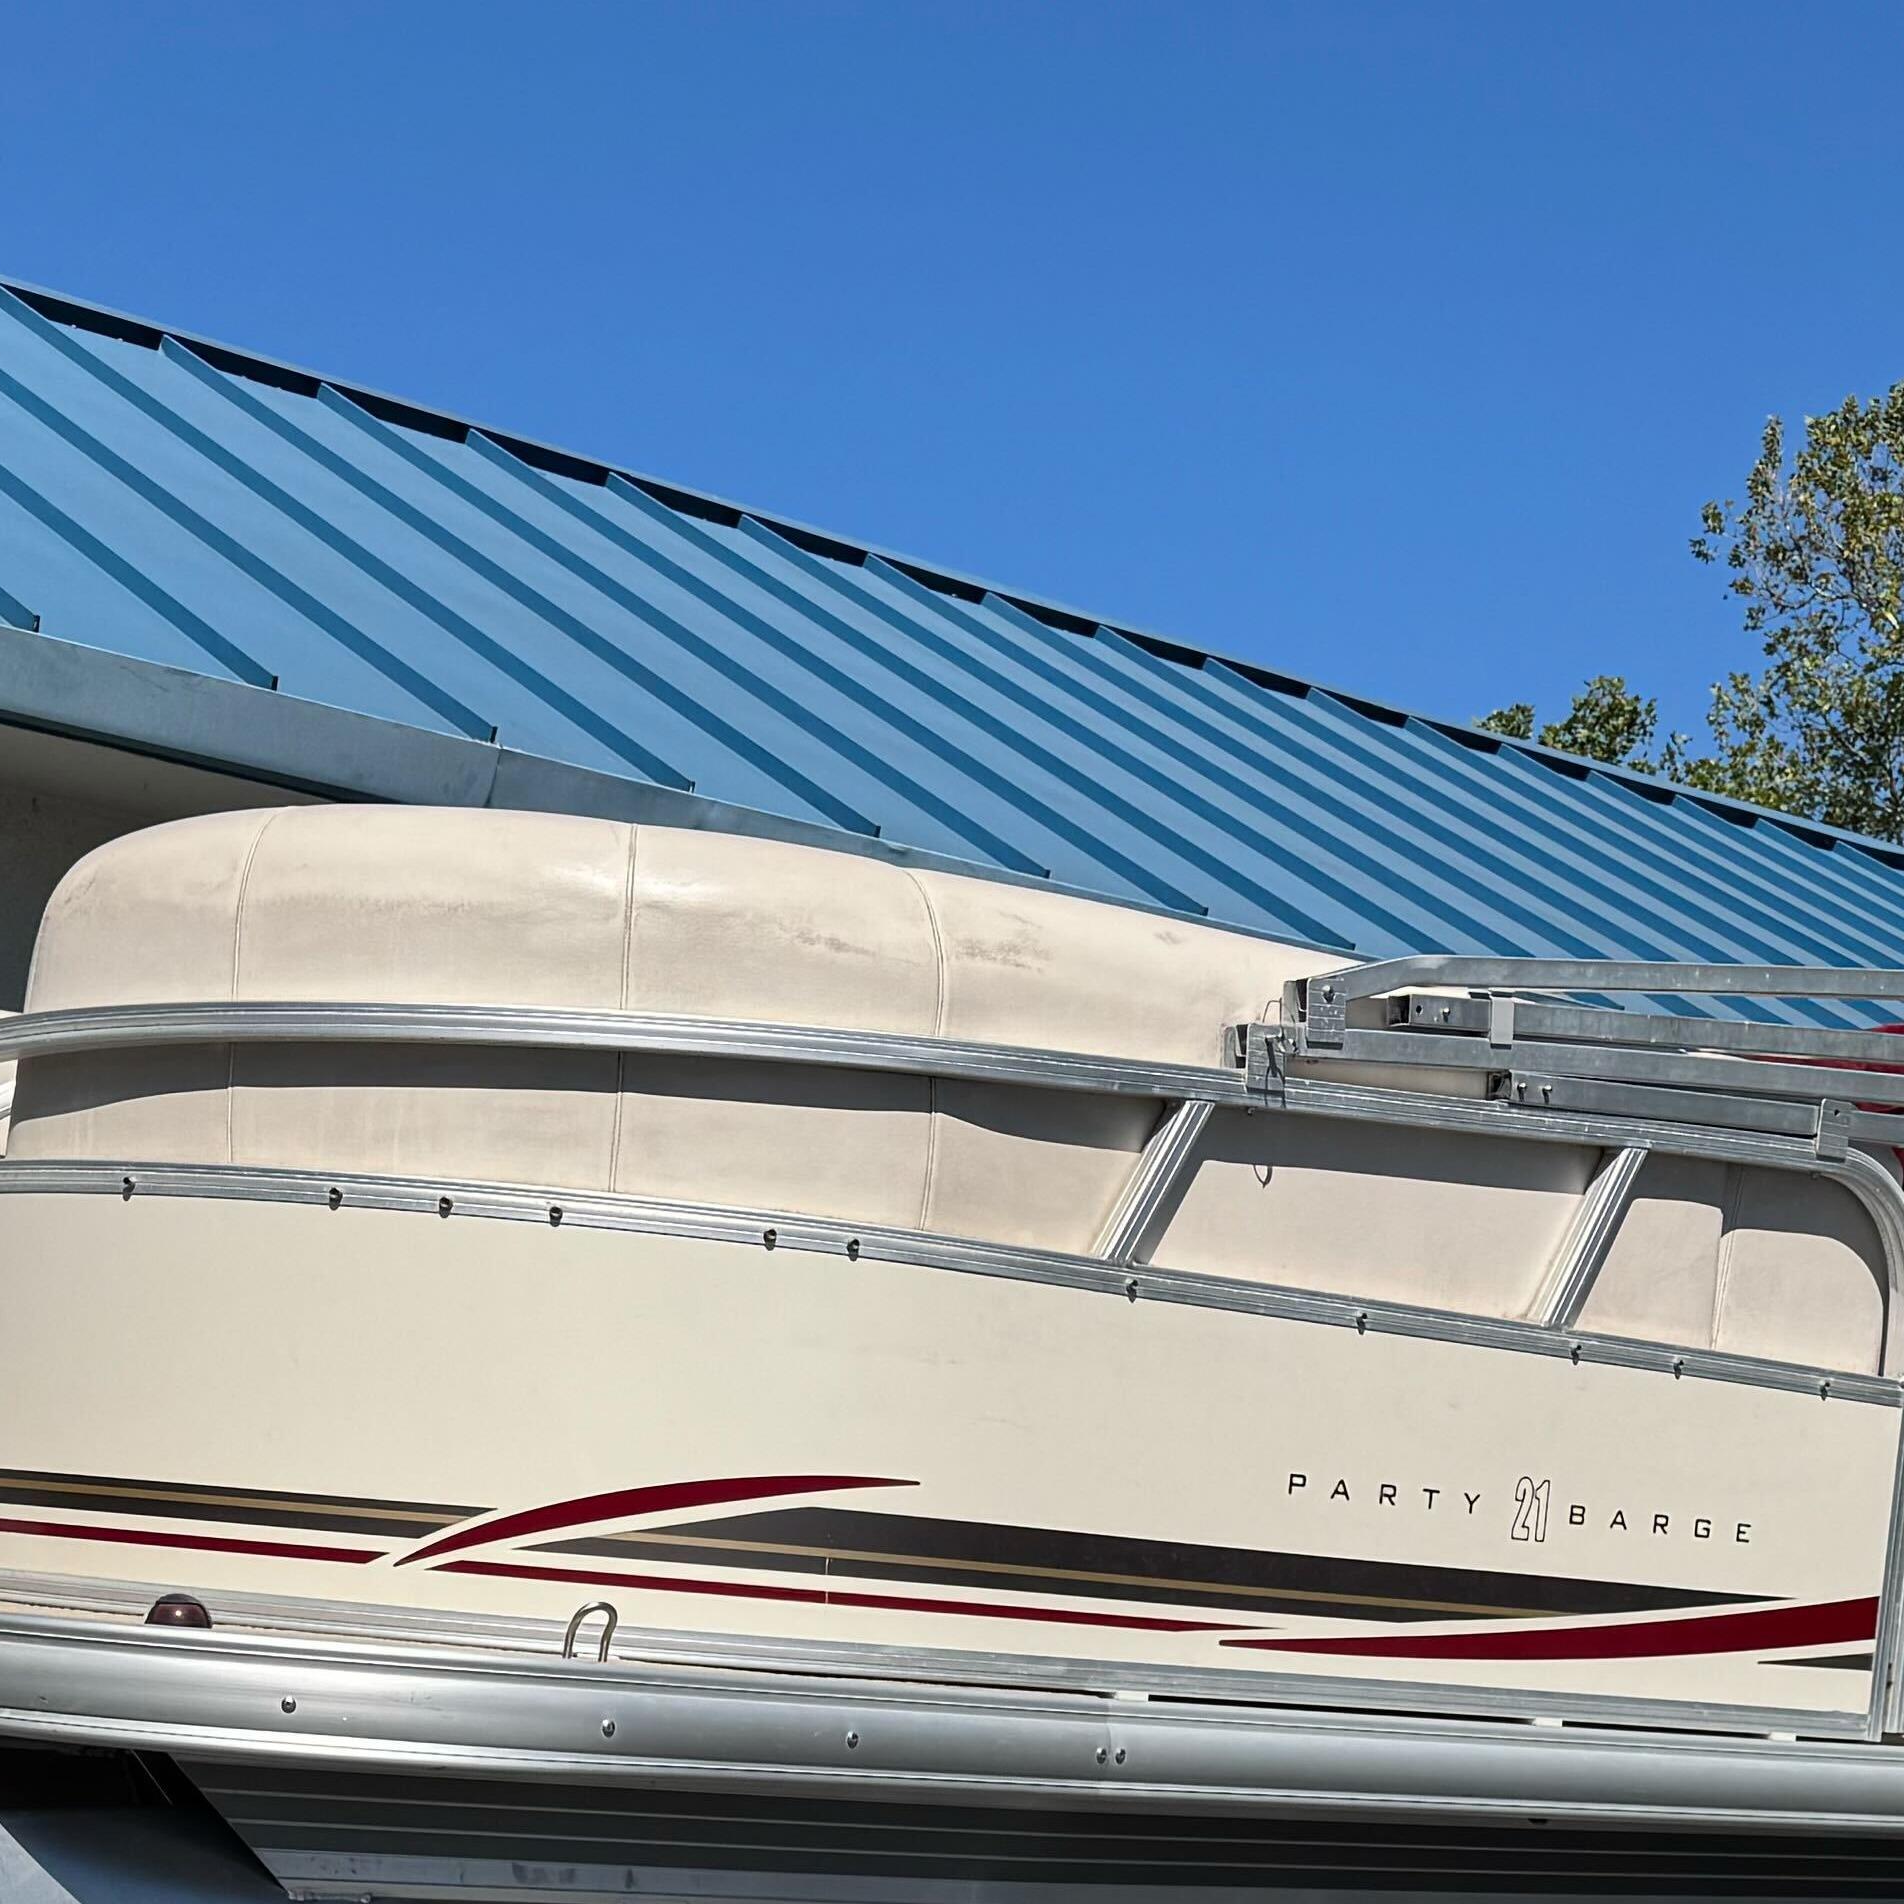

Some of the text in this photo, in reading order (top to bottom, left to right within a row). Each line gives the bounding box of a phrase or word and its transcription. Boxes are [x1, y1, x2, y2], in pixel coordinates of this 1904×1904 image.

[1287, 1473, 1753, 1544] PARTY 21 BARGE
